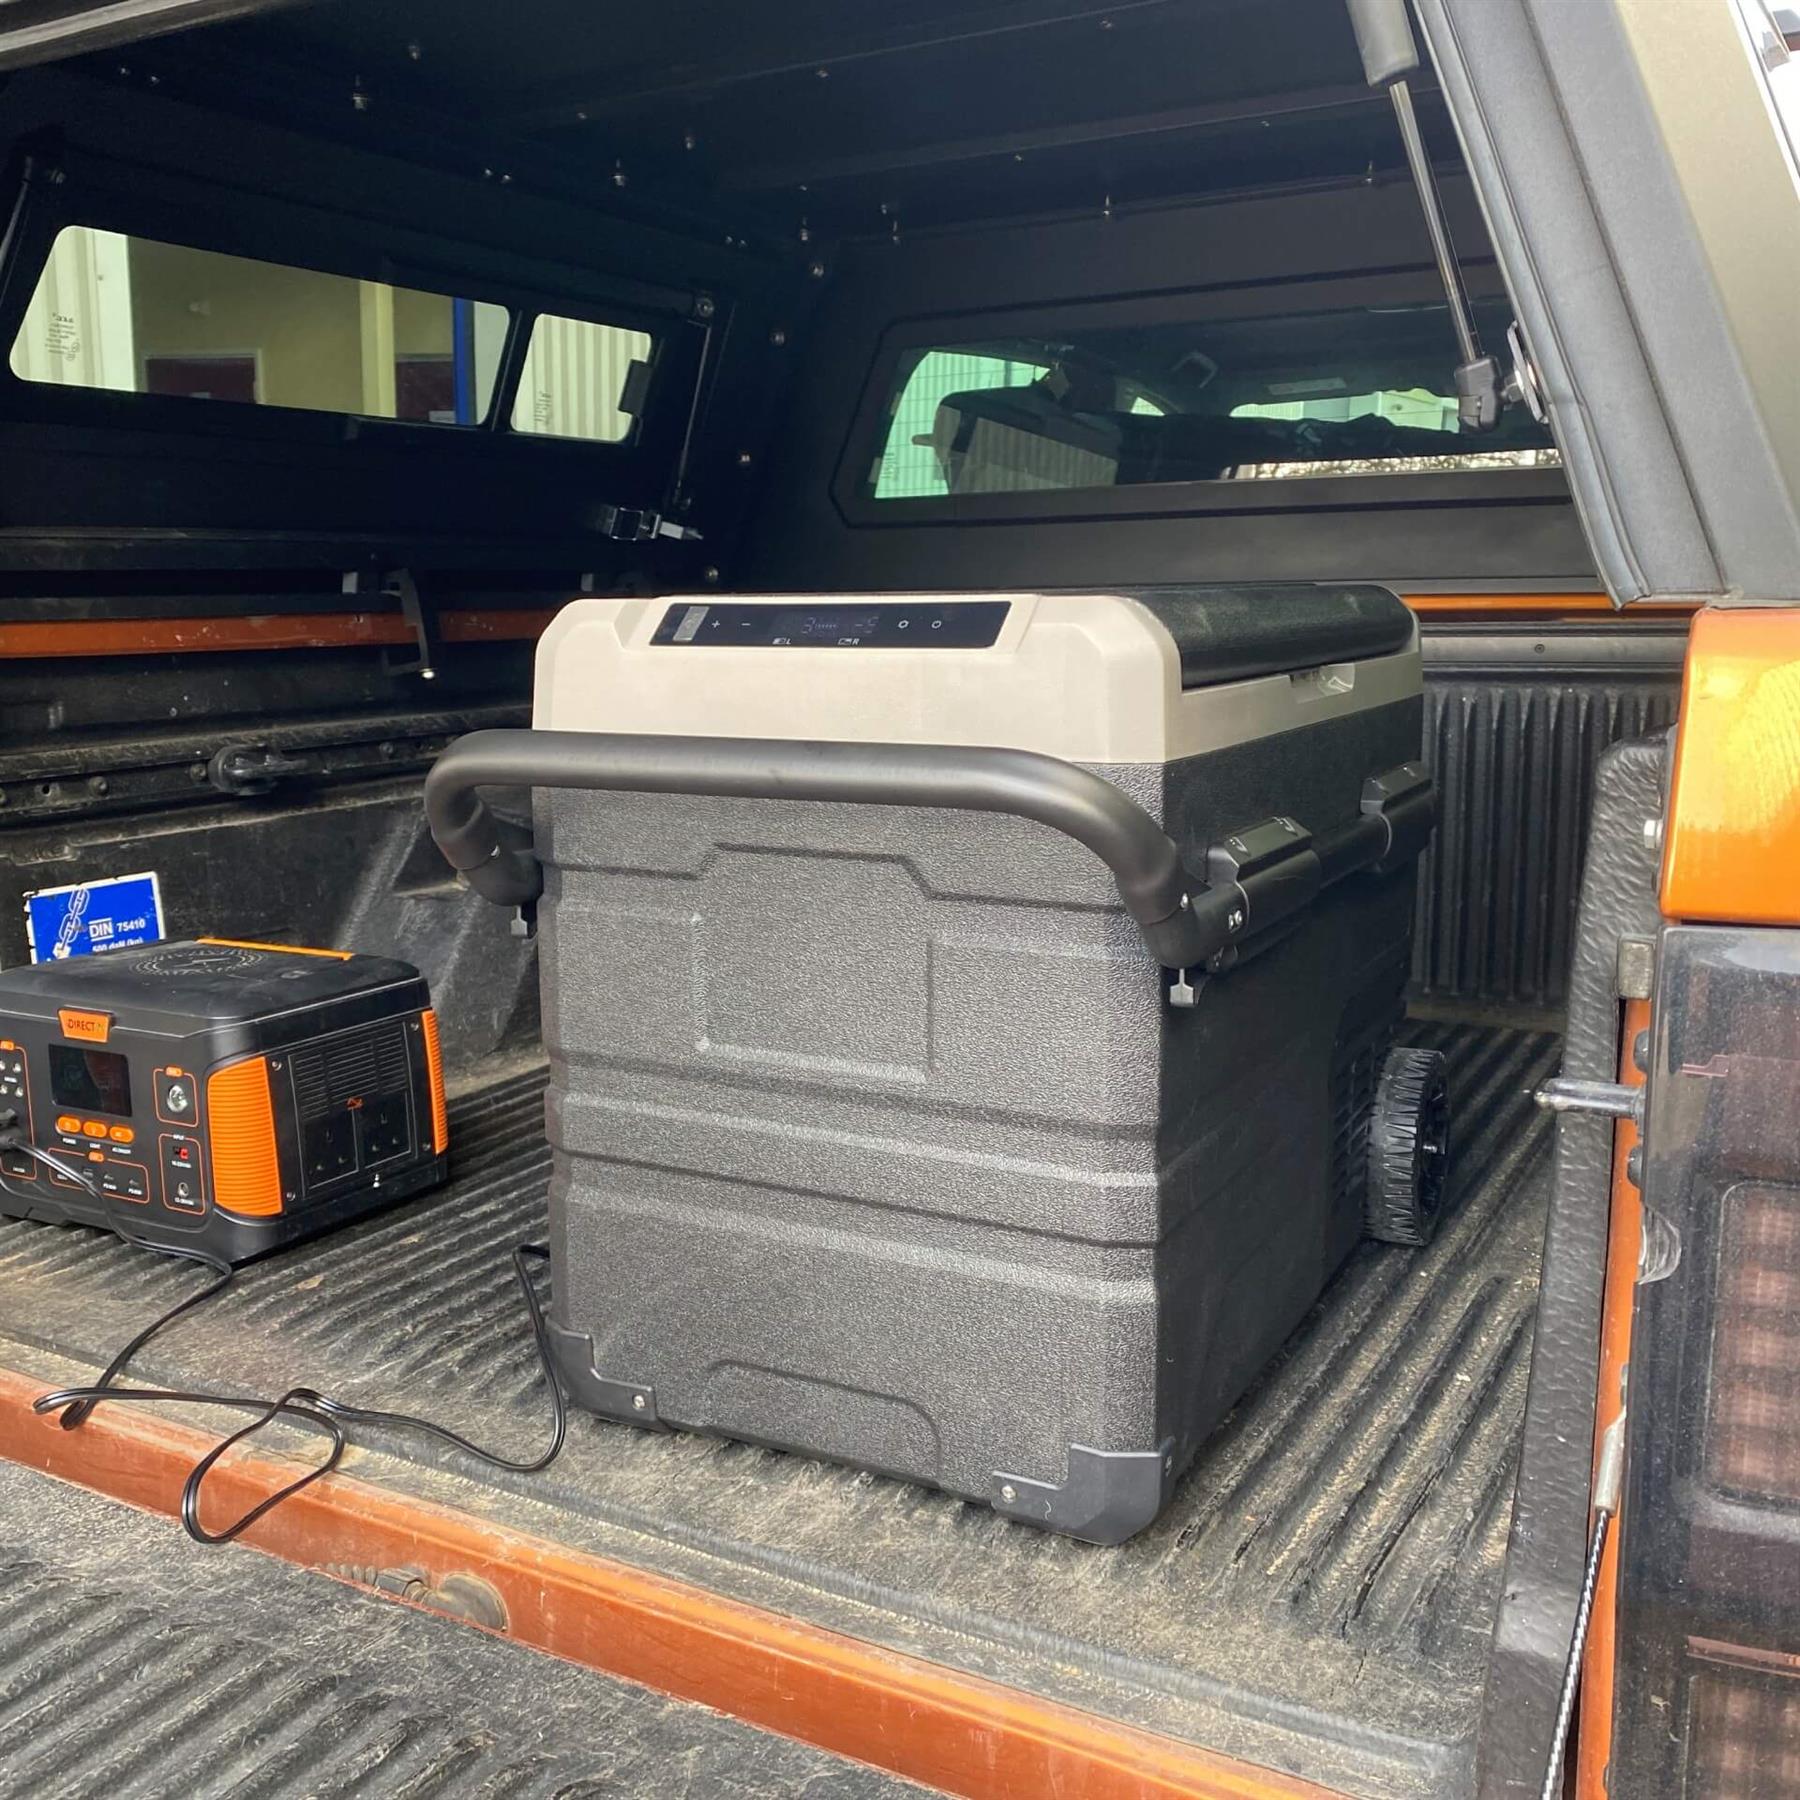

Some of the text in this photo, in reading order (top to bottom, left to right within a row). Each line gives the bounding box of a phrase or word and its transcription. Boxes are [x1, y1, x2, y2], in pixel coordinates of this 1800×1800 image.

[89, 918, 146, 938] DIN 75410
[67, 1018, 95, 1032] DIRECT
